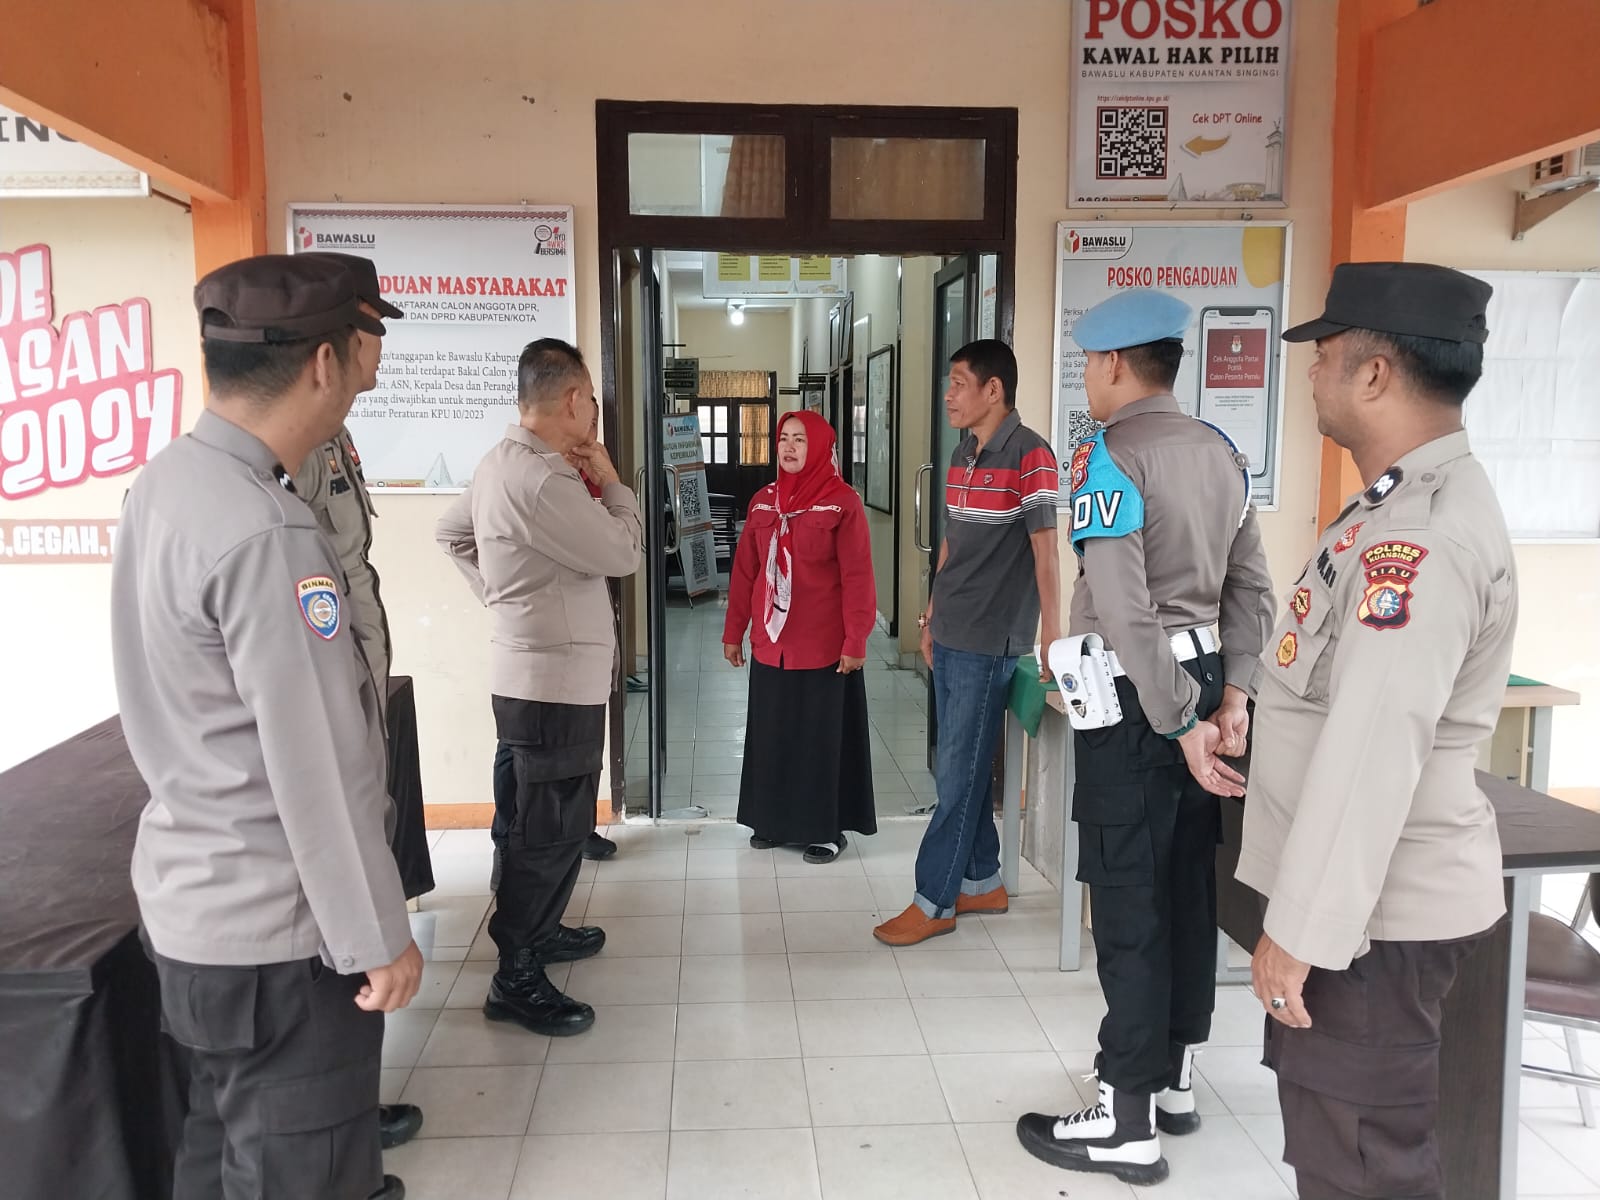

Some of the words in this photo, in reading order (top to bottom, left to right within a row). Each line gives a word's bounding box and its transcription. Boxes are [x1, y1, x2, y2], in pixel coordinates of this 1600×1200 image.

[1085, 0, 1282, 39] POSKO
[1083, 47, 1159, 64] KAWAL
[1167, 47, 1214, 64] HAK
[1221, 46, 1279, 63] PILIH
[1081, 70, 1126, 78] BAWASLU
[1129, 70, 1184, 78] KABUPATEN
[1189, 69, 1232, 77] KUANTAN
[1236, 69, 1279, 77] SINGINGI
[1192, 113, 1210, 123] Cek
[1212, 113, 1230, 124] DPT
[1234, 113, 1263, 124] Online
[316, 233, 375, 243] BAWASLU
[1082, 236, 1126, 246] BAWASLU
[1107, 266, 1152, 287] POSKO
[1157, 266, 1238, 286] PENGADUAN
[437, 276, 567, 297] MASYARAKAT
[441, 301, 471, 311] CALON
[473, 302, 516, 311] ANGGOTA
[518, 302, 540, 313] DPR,
[410, 312, 429, 320] DAN
[431, 312, 456, 321] DPRD
[458, 313, 537, 322] KABUPATEN/KOTA
[436, 351, 446, 361] ke
[448, 351, 482, 362] Bawaslu
[378, 364, 403, 375] dalam
[405, 364, 418, 375] hal
[420, 365, 456, 379] terdapat
[457, 366, 480, 376] Bakal
[482, 366, 506, 377] Calon
[391, 380, 412, 391] ASN,
[414, 380, 442, 393] Kepala
[444, 380, 464, 391] Desa
[466, 381, 481, 391] dan
[369, 396, 388, 407] yang
[390, 393, 437, 408] diwajibkan
[439, 394, 464, 405] untuk
[361, 408, 386, 418] diatur
[388, 408, 429, 419] Peraturan
[431, 409, 450, 419] KPU
[452, 409, 484, 420] 10/2023
[2, 374, 175, 494] 2024
[1365, 544, 1422, 560] POLRES
[1370, 567, 1410, 578] RIAU
[301, 579, 334, 590] BINMAS
